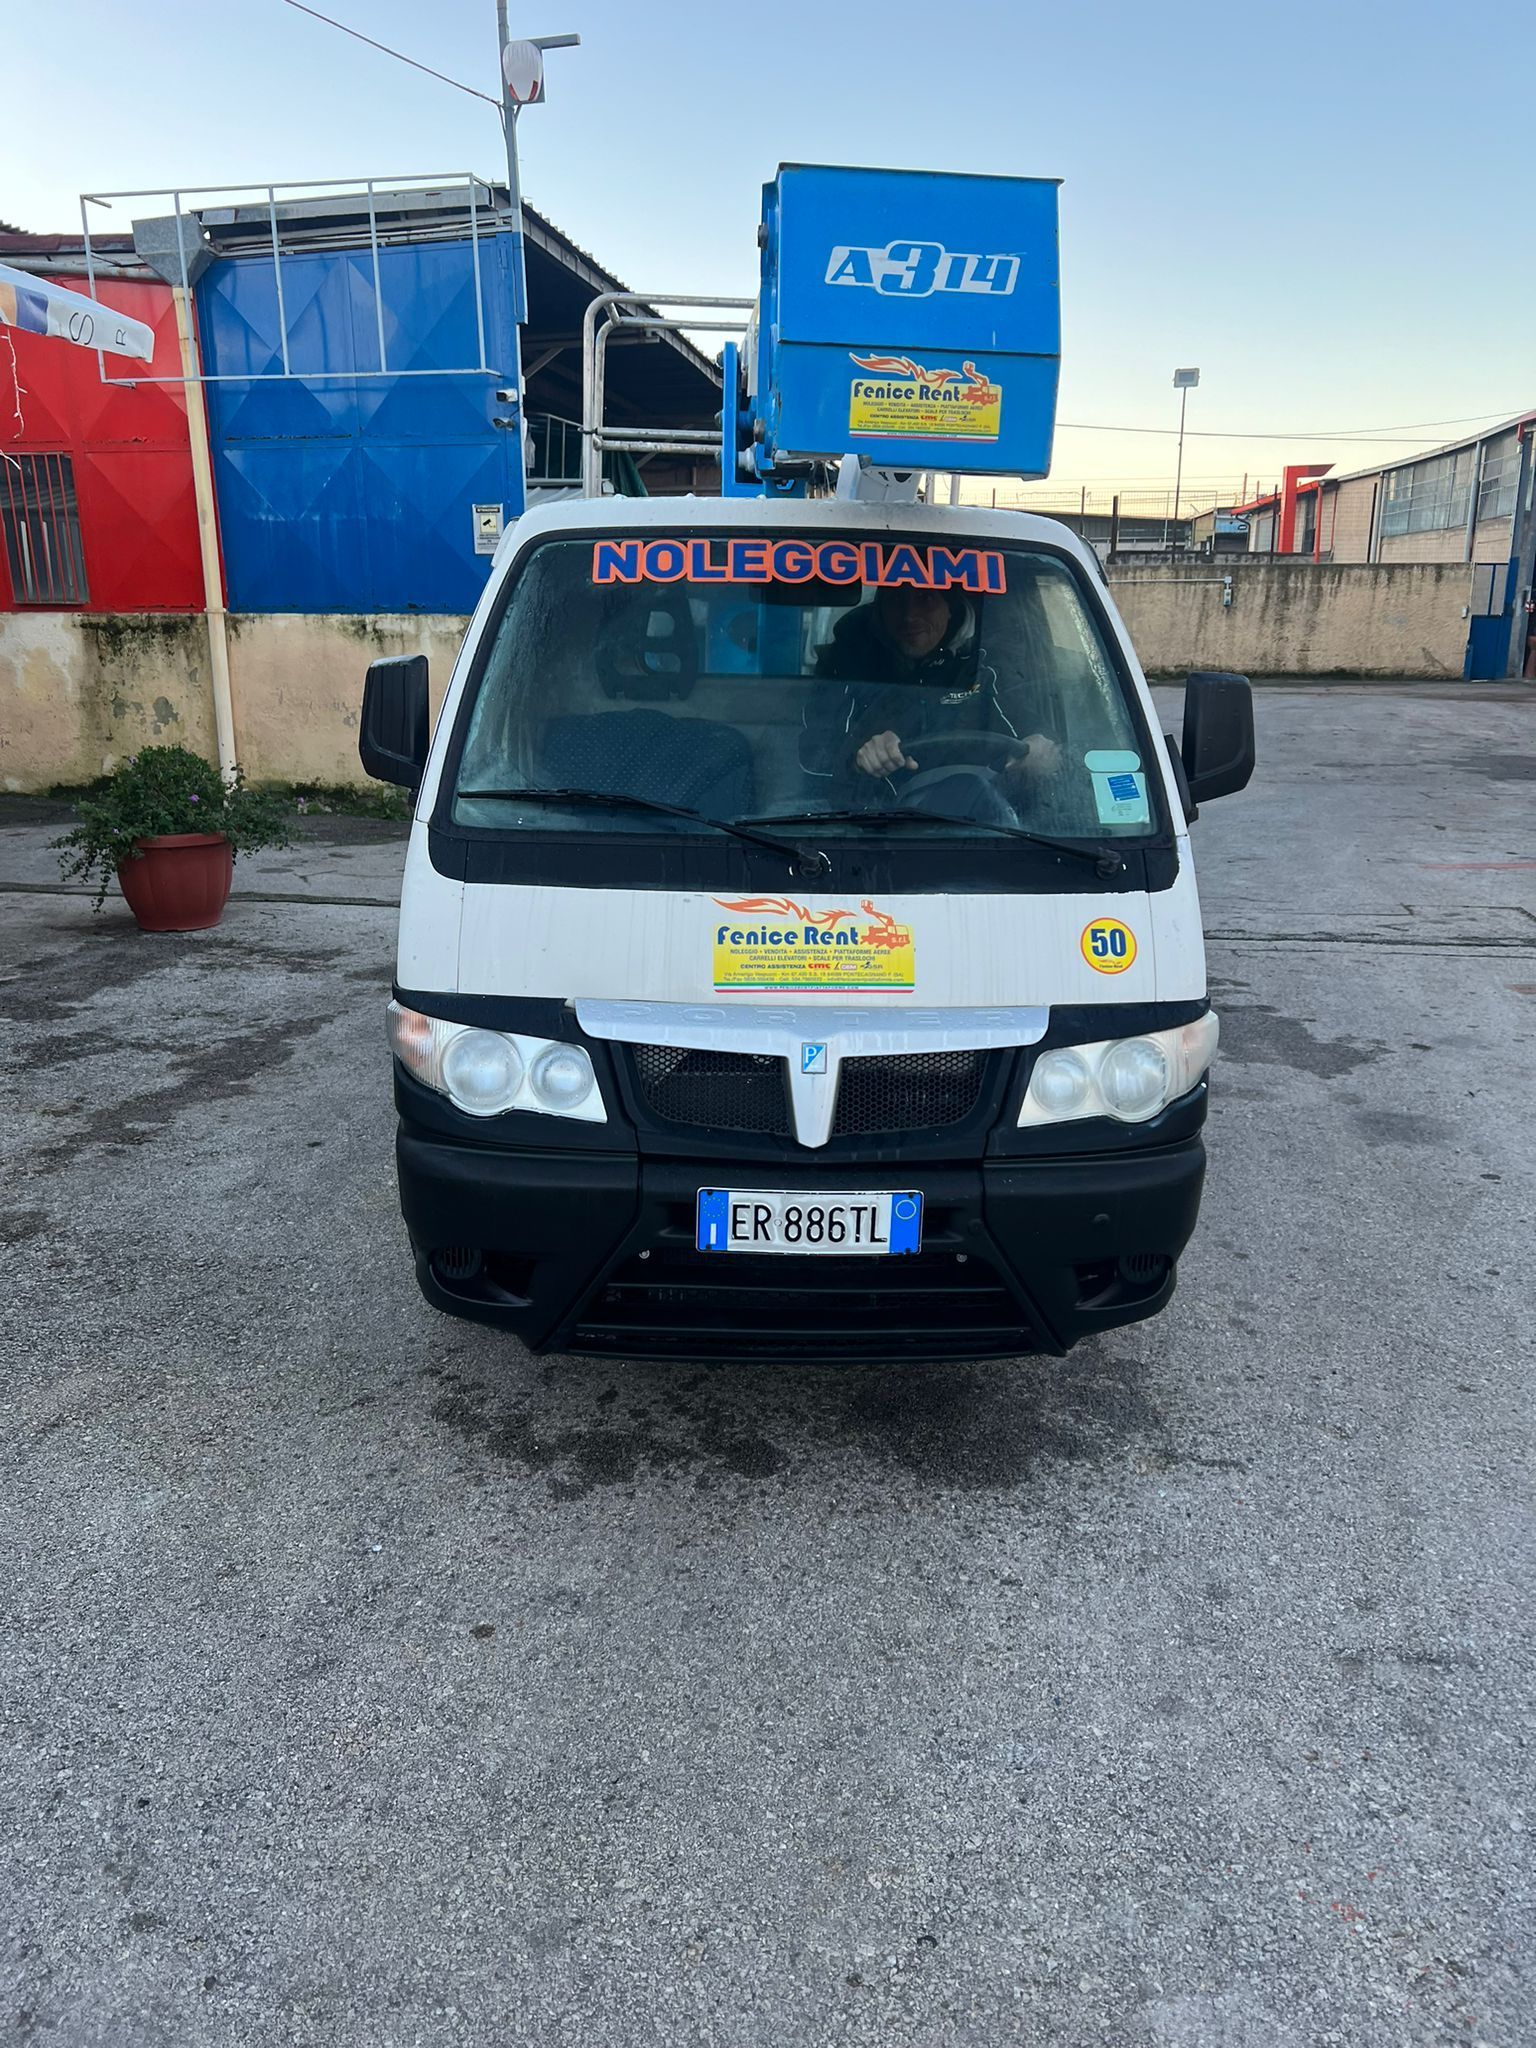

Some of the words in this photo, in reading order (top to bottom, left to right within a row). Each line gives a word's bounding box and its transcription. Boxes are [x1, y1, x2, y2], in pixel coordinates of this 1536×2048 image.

[825, 240, 1020, 297] A314
[854, 382, 915, 400] Fenice
[919, 384, 960, 402] Rent
[593, 539, 1006, 593] NOLEGGIAMI
[717, 925, 799, 946] Fenice
[804, 926, 859, 946] Rent
[1091, 928, 1126, 957] 50
[732, 1203, 772, 1242] ER
[784, 1205, 888, 1243] 886TL
